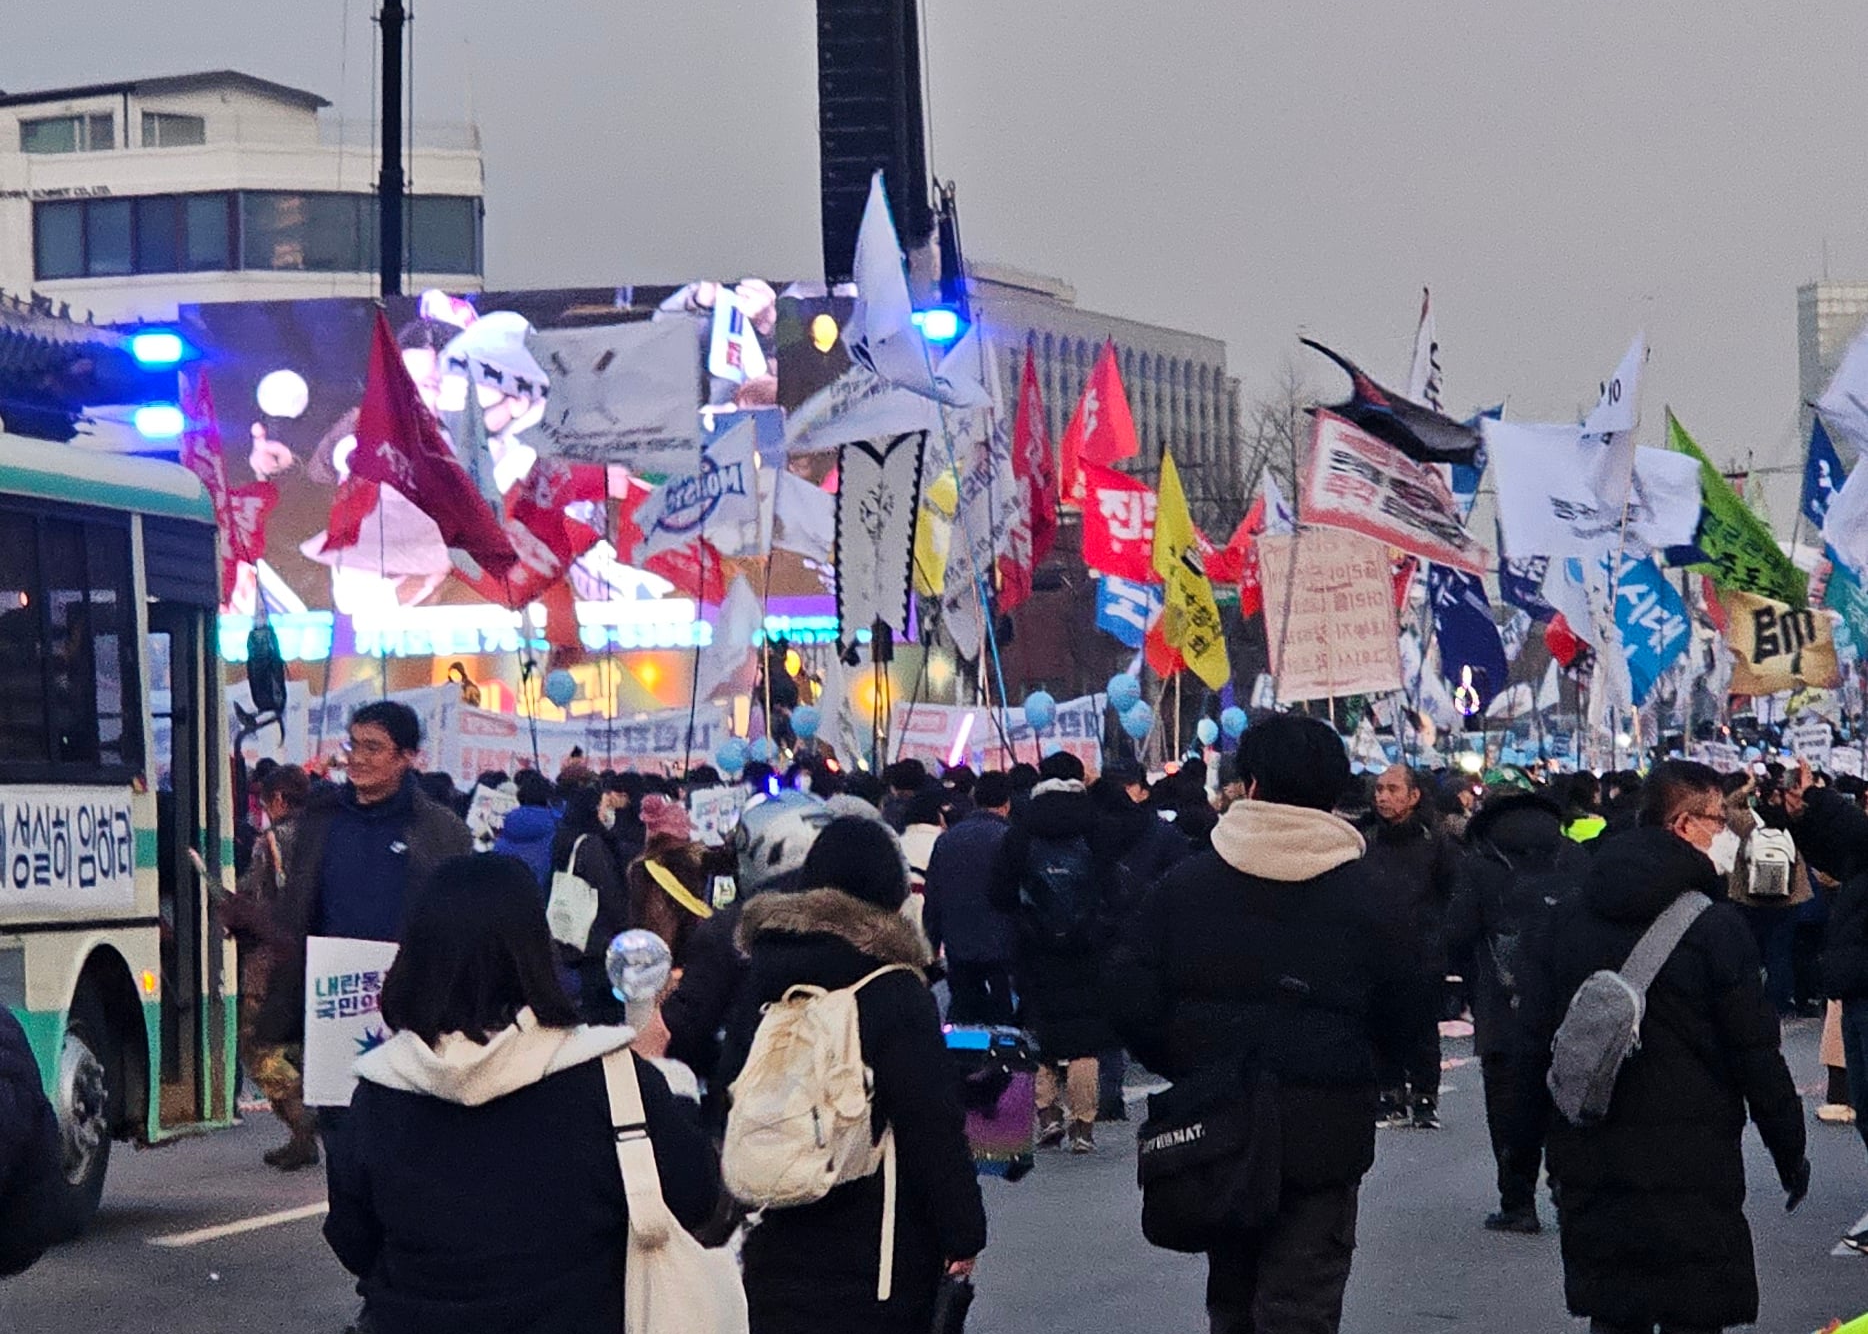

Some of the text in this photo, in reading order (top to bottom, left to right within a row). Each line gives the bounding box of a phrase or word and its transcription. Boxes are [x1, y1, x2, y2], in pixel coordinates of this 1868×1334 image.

[12, 801, 72, 889] 성실히
[77, 803, 133, 889] 임하라
[315, 971, 382, 998] 내란동
[315, 994, 382, 1019] 국민의
